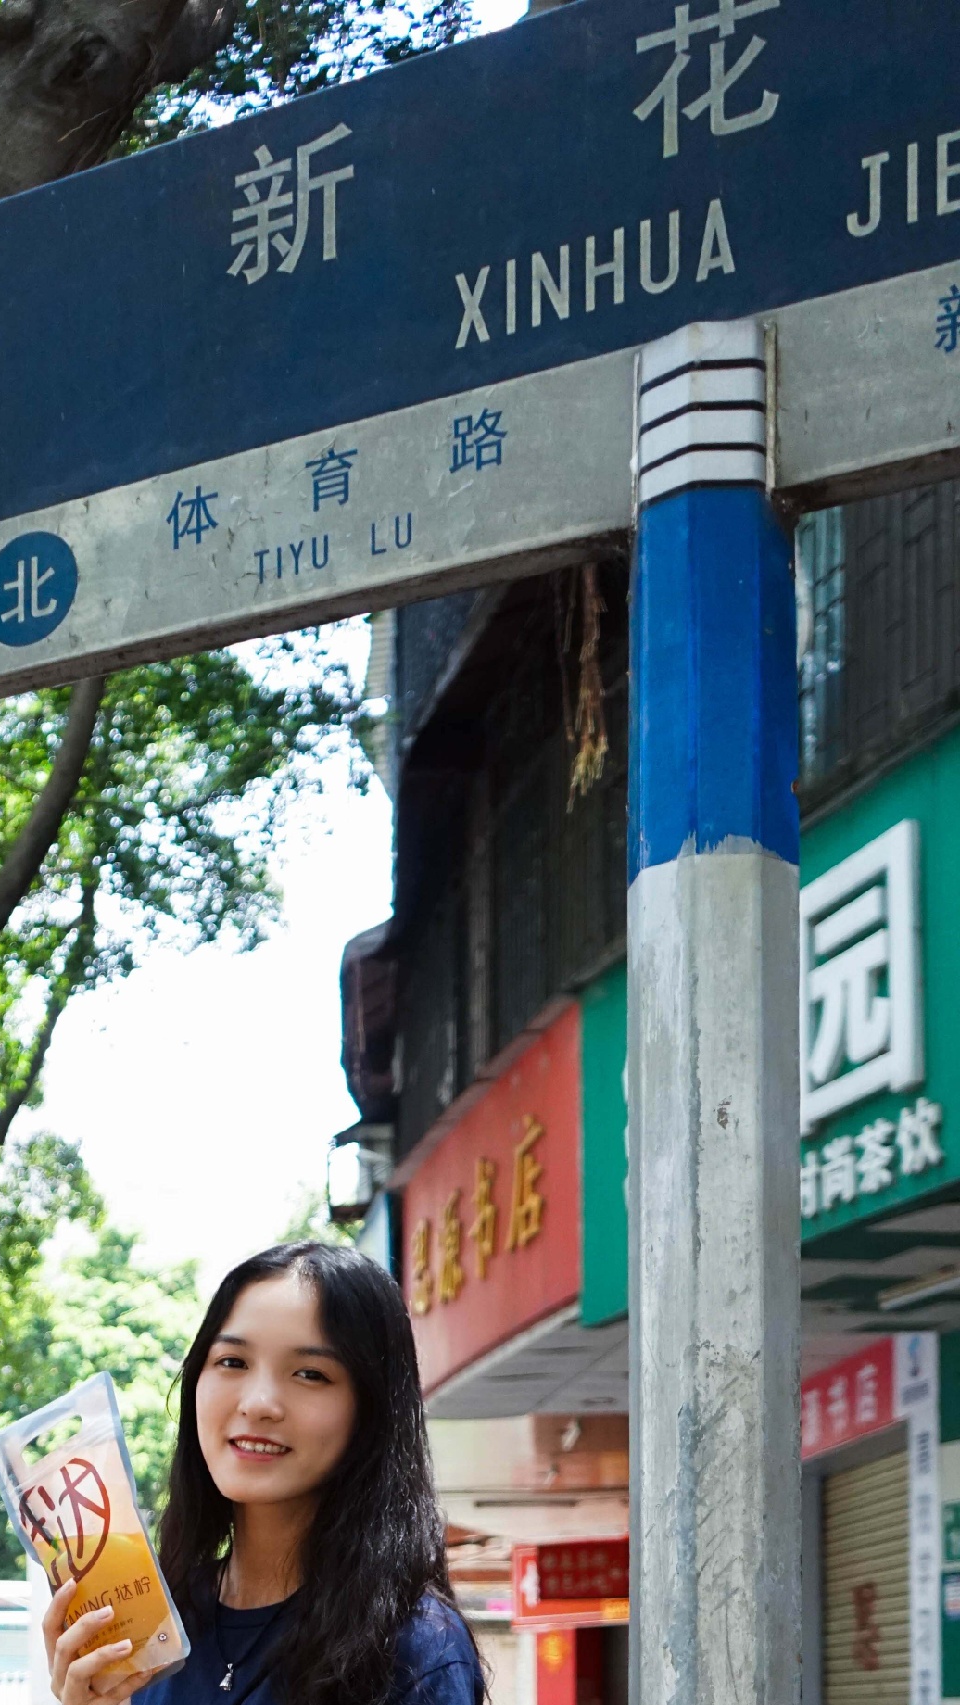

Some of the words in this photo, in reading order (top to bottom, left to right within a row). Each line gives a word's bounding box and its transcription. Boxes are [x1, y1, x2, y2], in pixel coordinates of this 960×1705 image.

[455, 198, 736, 350] XINHUA
[846, 129, 960, 237] JIE
[166, 408, 509, 550] 体育路
[253, 534, 330, 584] TIYU
[371, 512, 413, 556] LU
[0, 556, 58, 623] 北
[65, 1589, 114, 1627] ANING
